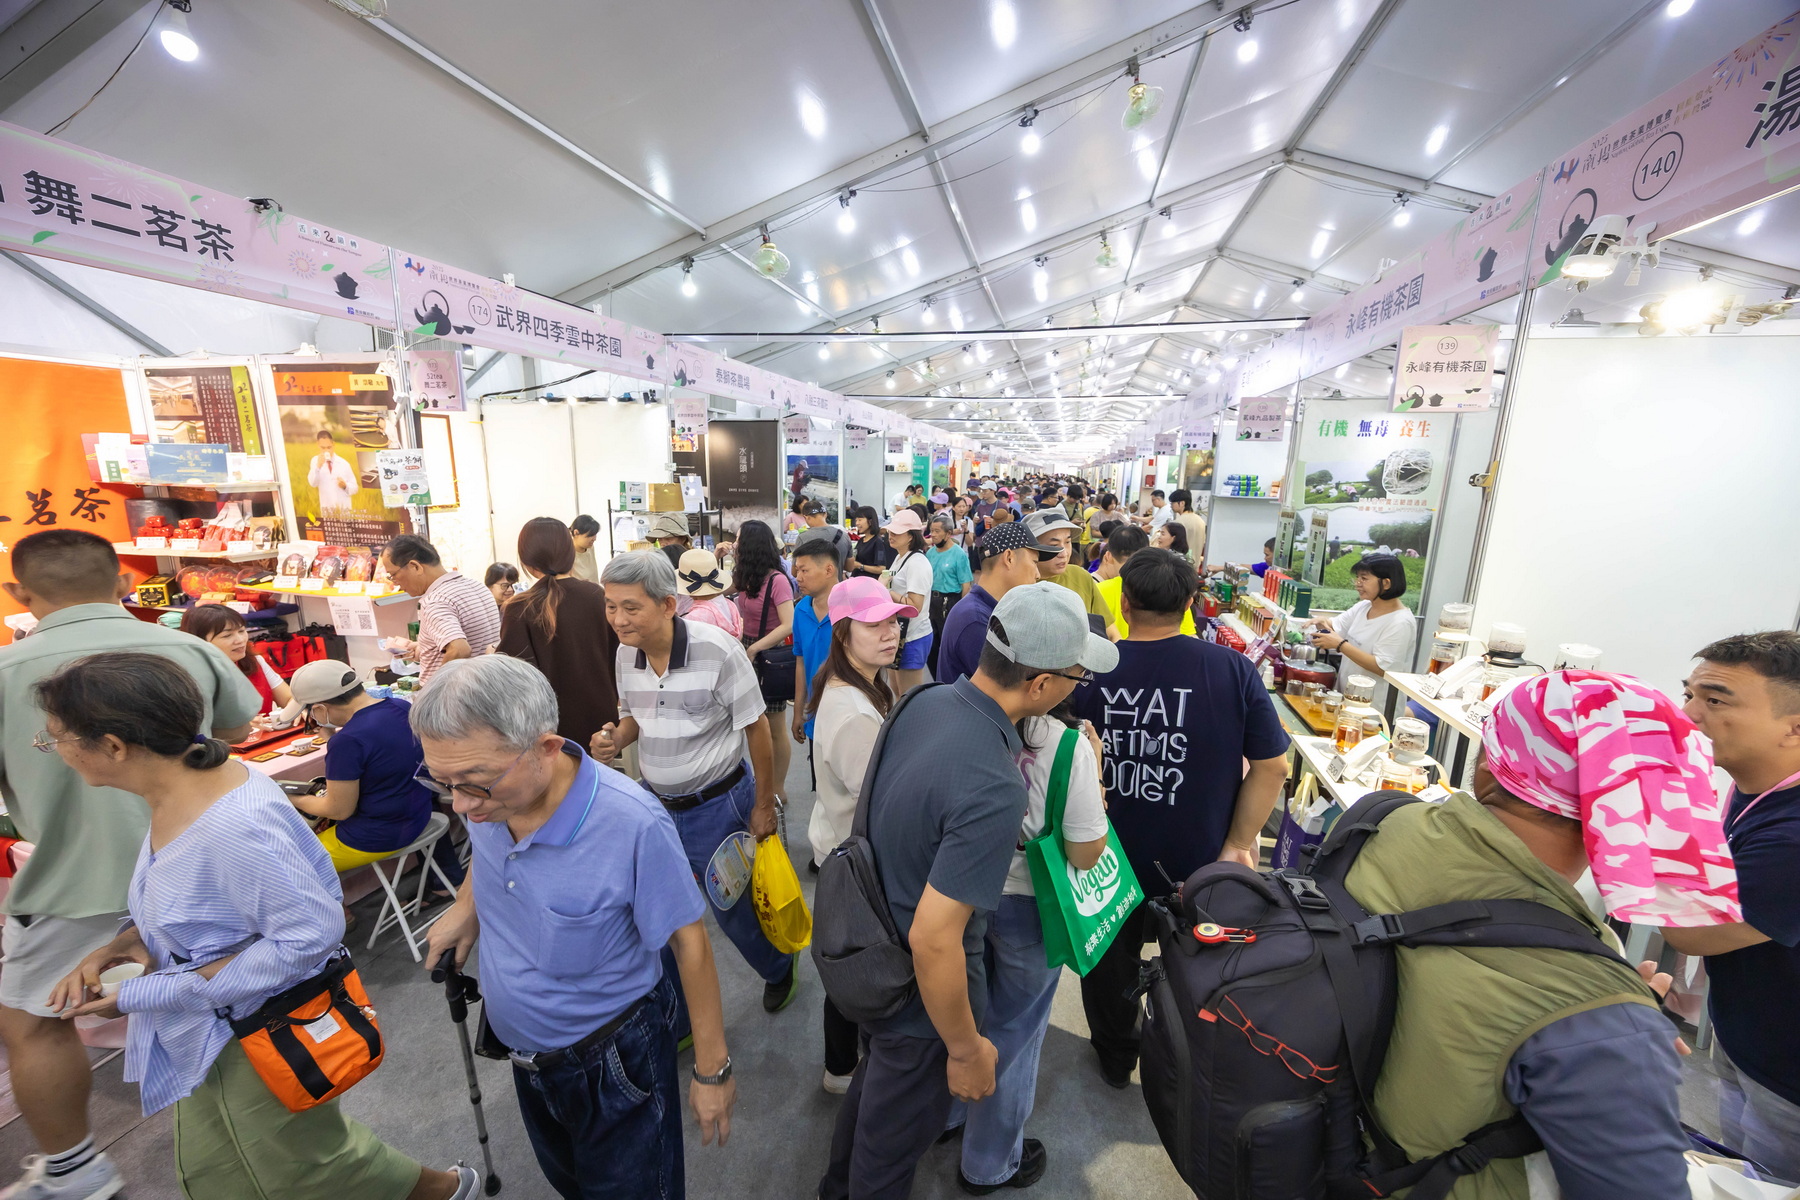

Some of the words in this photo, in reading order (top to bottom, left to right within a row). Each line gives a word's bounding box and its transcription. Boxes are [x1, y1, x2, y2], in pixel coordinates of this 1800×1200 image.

[1641, 150, 1676, 184] 140
[22, 169, 236, 263] 舞二茗茶
[472, 304, 488, 317] 174
[1345, 273, 1424, 340] 永峰有機茶園
[496, 304, 622, 358] 武界四季雲中茶園
[1440, 342, 1456, 350] 139
[1406, 361, 1487, 373] 永峰有機茶園
[1318, 419, 1349, 437] 有機
[1357, 419, 1389, 437] 無毒
[1400, 419, 1431, 438] 養生
[0, 487, 111, 526] 茗茶
[1069, 852, 1121, 903] Vegan
